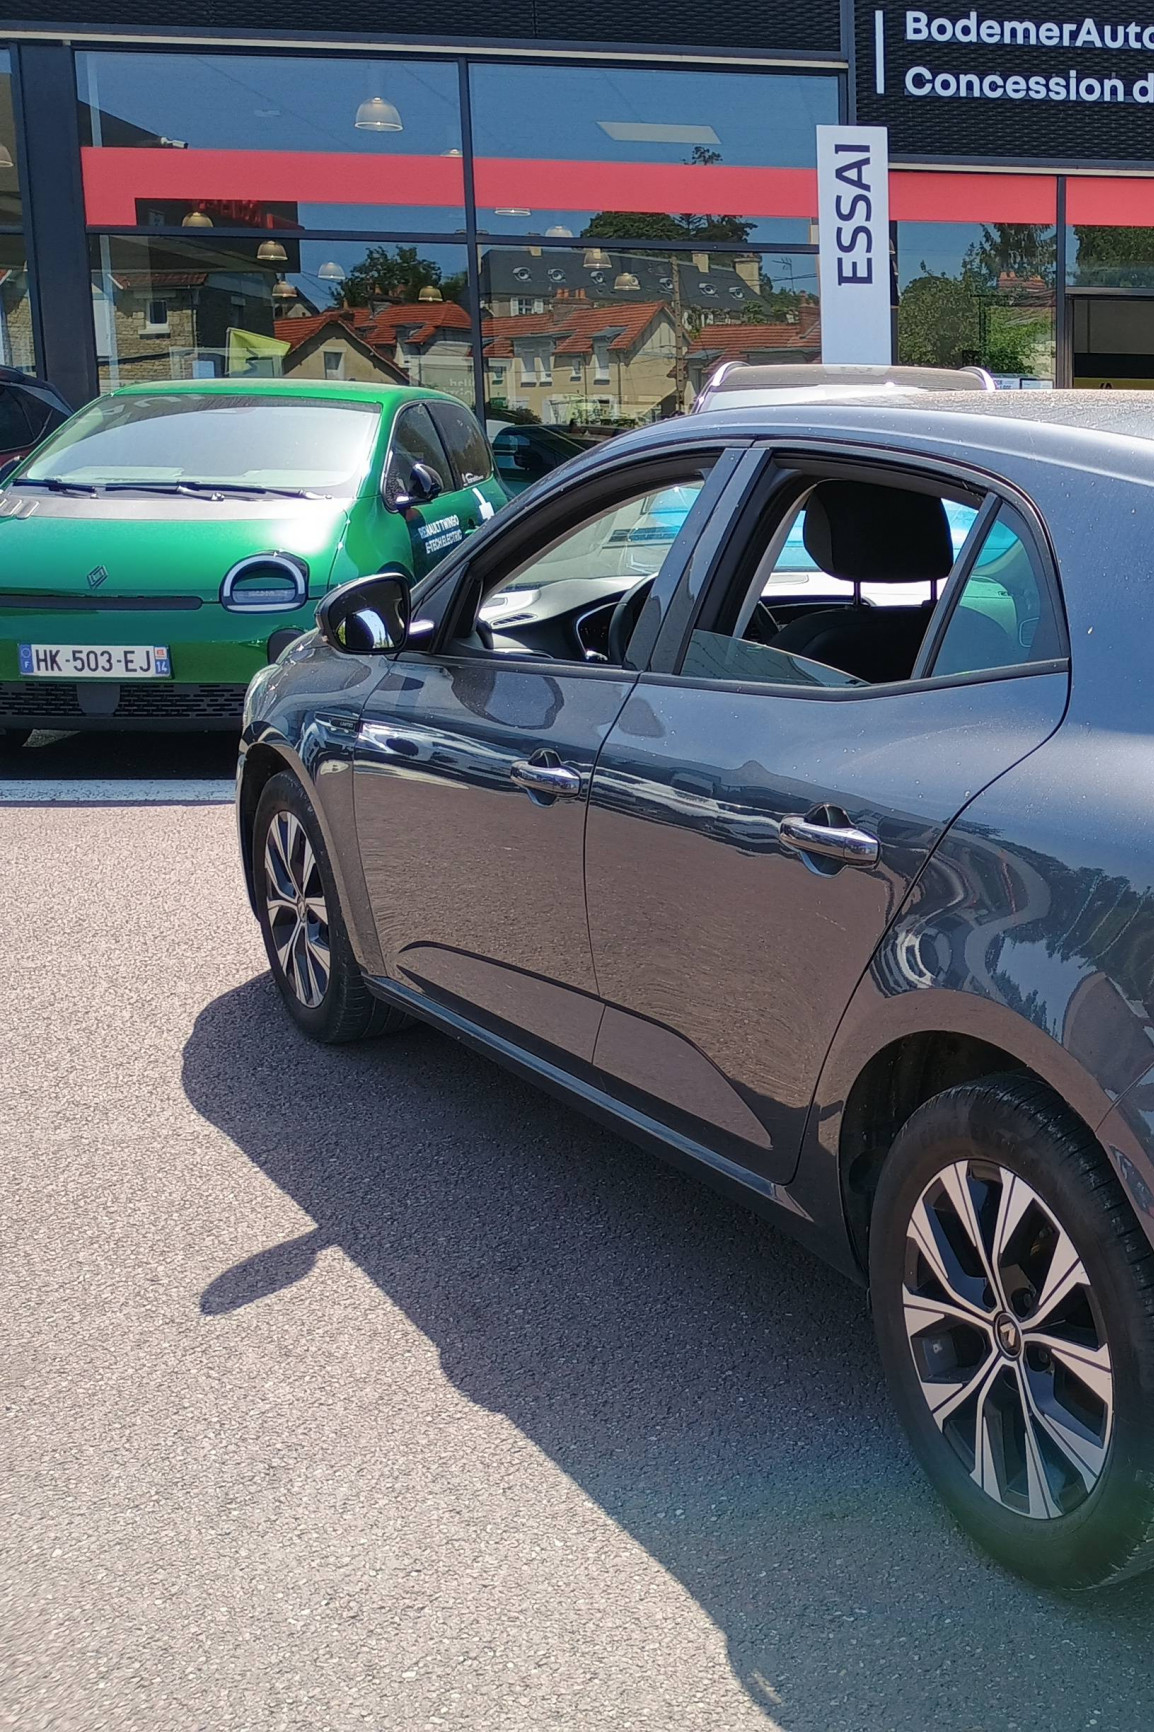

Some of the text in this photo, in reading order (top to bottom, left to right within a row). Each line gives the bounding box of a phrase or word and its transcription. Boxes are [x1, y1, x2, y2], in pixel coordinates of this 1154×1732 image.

[905, 66, 1125, 102] Concession
[834, 143, 874, 287] ESSAI
[35, 649, 151, 673] HK-503-EJ
[156, 661, 168, 672] 14
